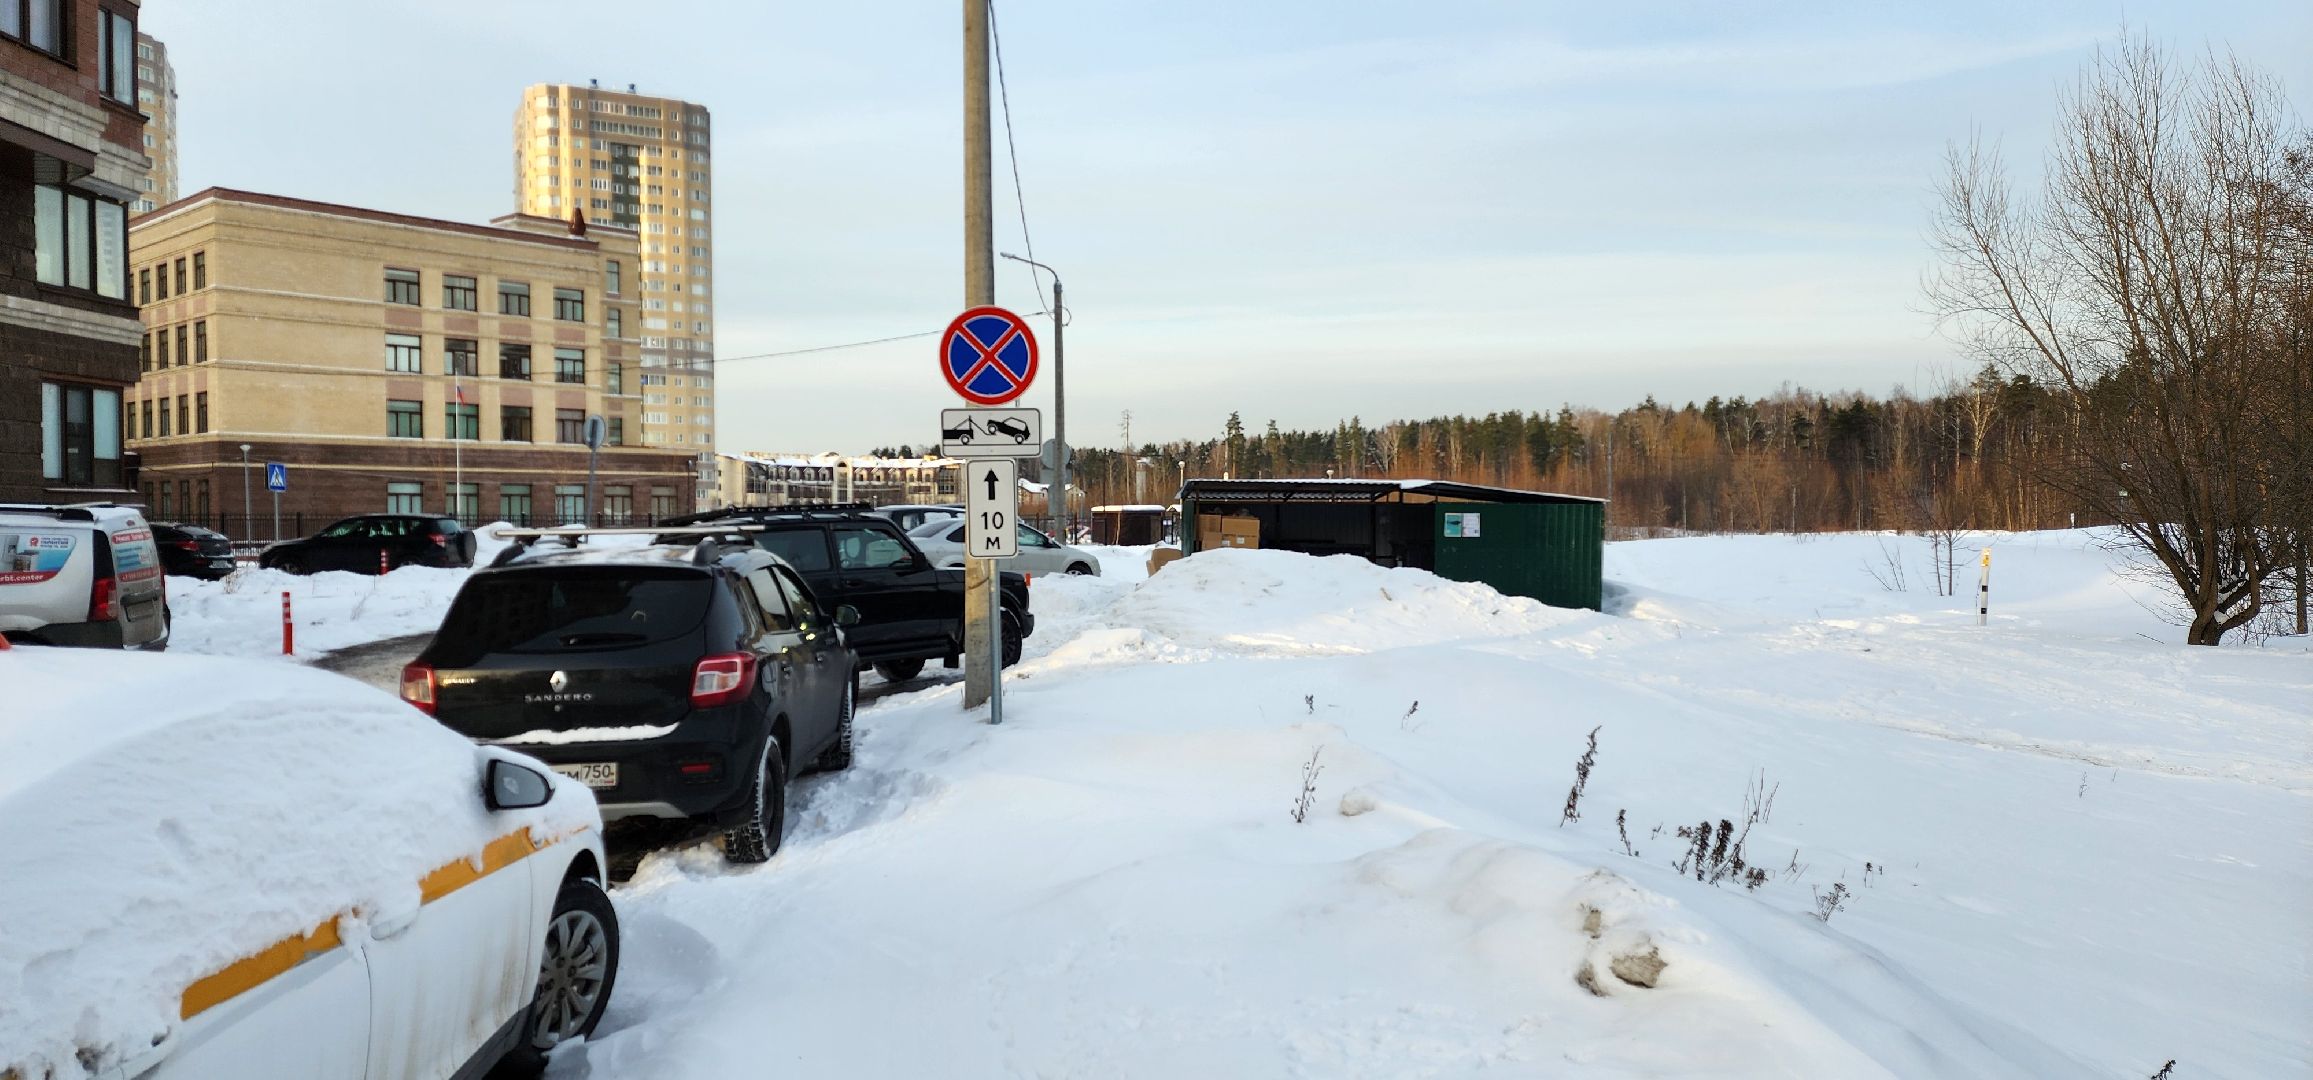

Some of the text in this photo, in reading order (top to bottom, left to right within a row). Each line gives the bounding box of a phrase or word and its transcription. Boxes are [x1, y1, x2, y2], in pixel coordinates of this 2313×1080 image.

[980, 511, 1004, 530] 10
[524, 693, 593, 703] SANDERO
[583, 765, 611, 779] 750
